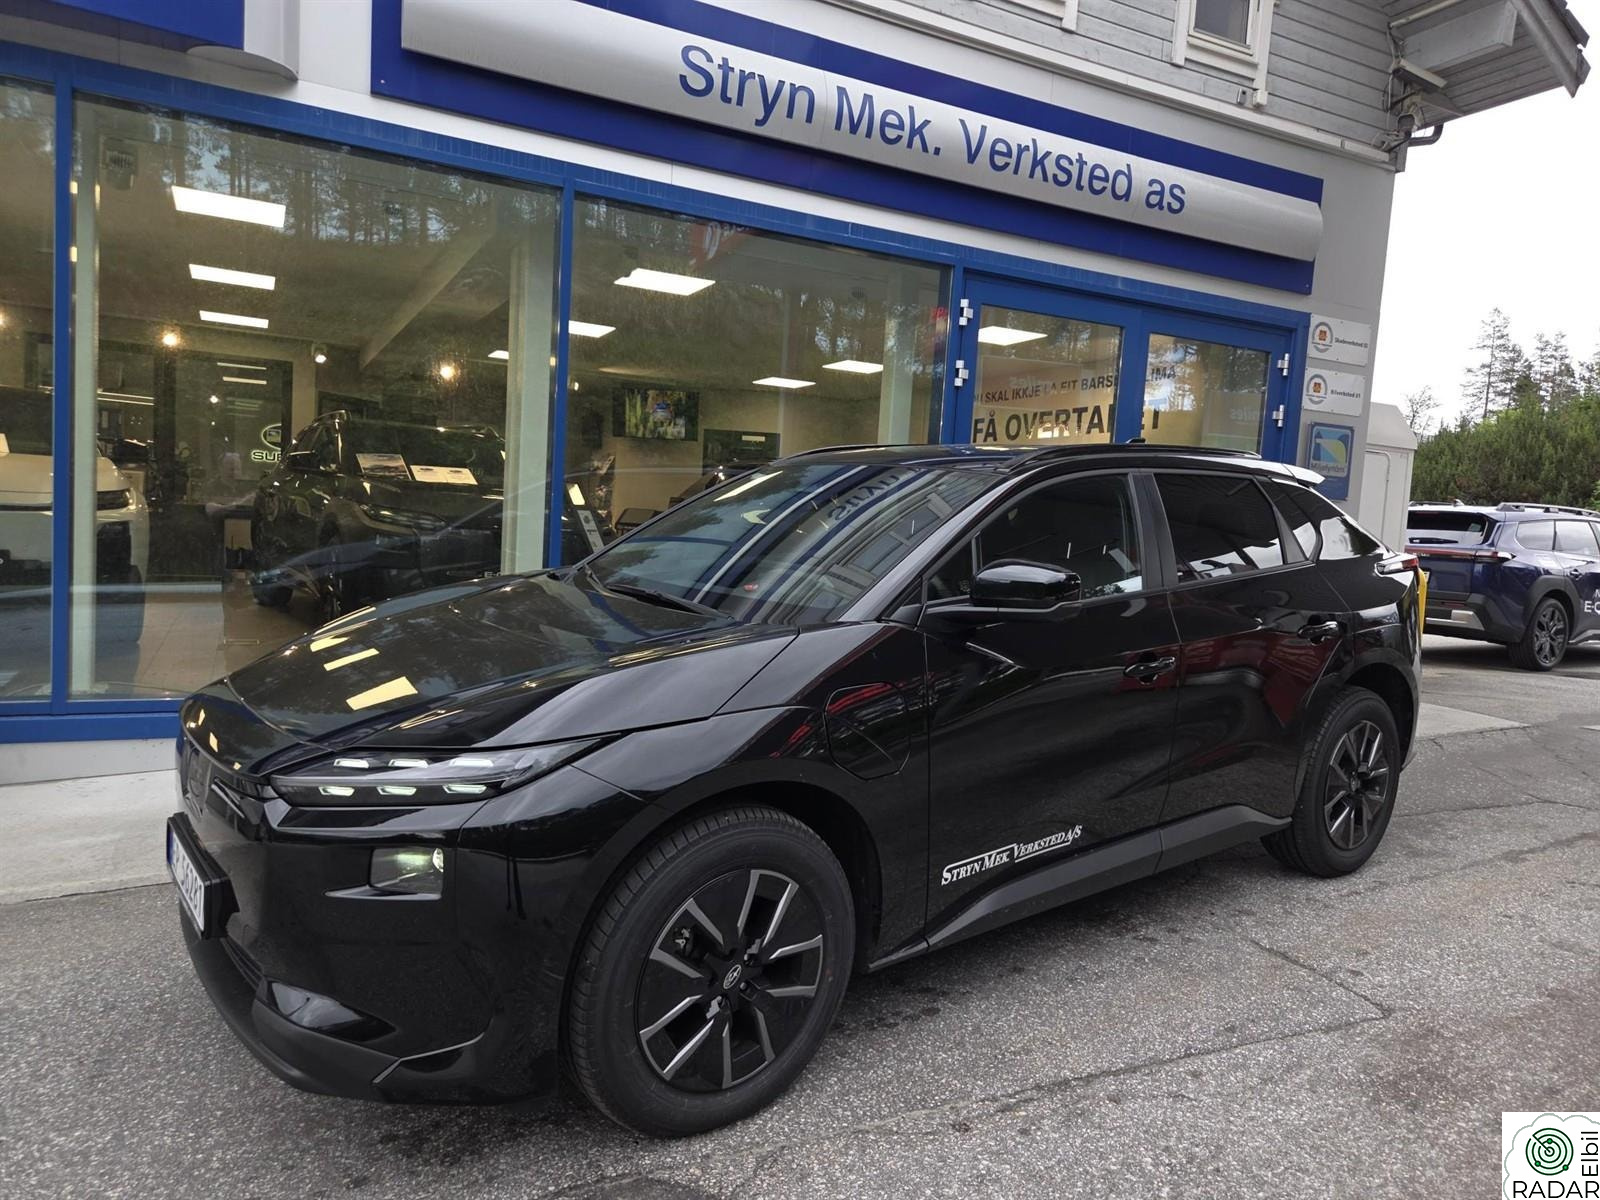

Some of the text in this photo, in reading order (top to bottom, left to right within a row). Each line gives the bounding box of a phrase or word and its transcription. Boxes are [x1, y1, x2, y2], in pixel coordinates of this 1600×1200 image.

[678, 44, 1186, 215] Stryn Mek. Verksted as
[984, 390, 1010, 403] SKAL
[1011, 384, 1041, 401] IKKJE
[1060, 380, 1079, 391] EIT
[1080, 375, 1116, 390] BARS
[972, 408, 998, 443] FÅ
[1064, 825, 1082, 843] A/S
